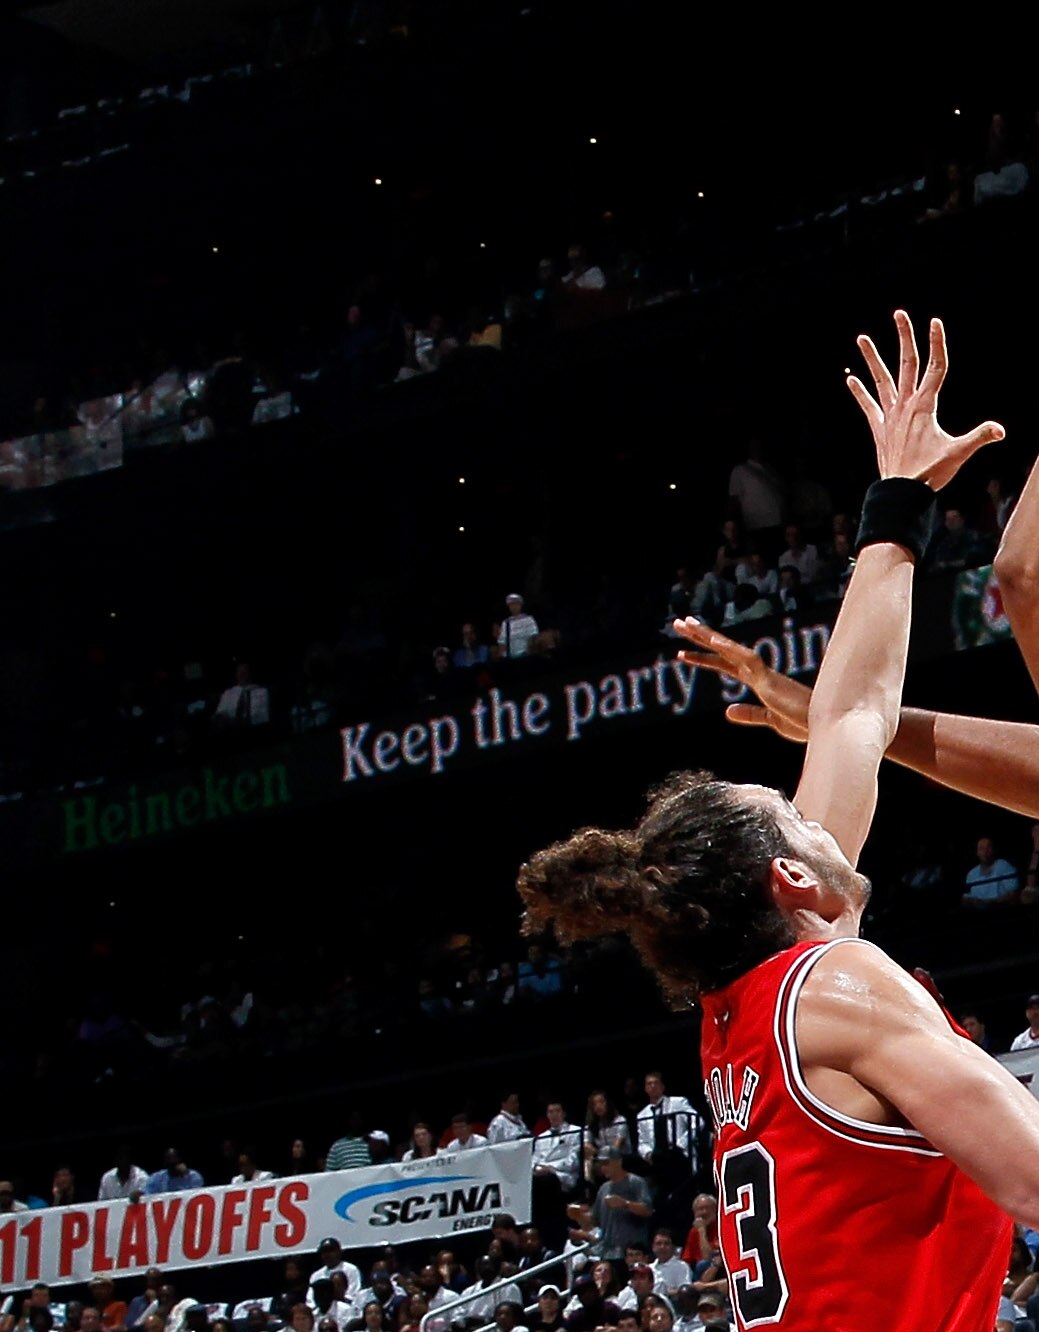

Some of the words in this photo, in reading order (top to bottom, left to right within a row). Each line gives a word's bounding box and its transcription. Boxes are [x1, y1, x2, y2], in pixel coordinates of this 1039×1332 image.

[338, 711, 462, 783] Keep
[470, 686, 552, 751] the
[564, 650, 699, 742] party
[59, 760, 294, 853] Heineken
[58, 1180, 310, 1278] PLAYOFFS
[368, 1182, 503, 1227] SCANA
[713, 1140, 790, 1331] 3
